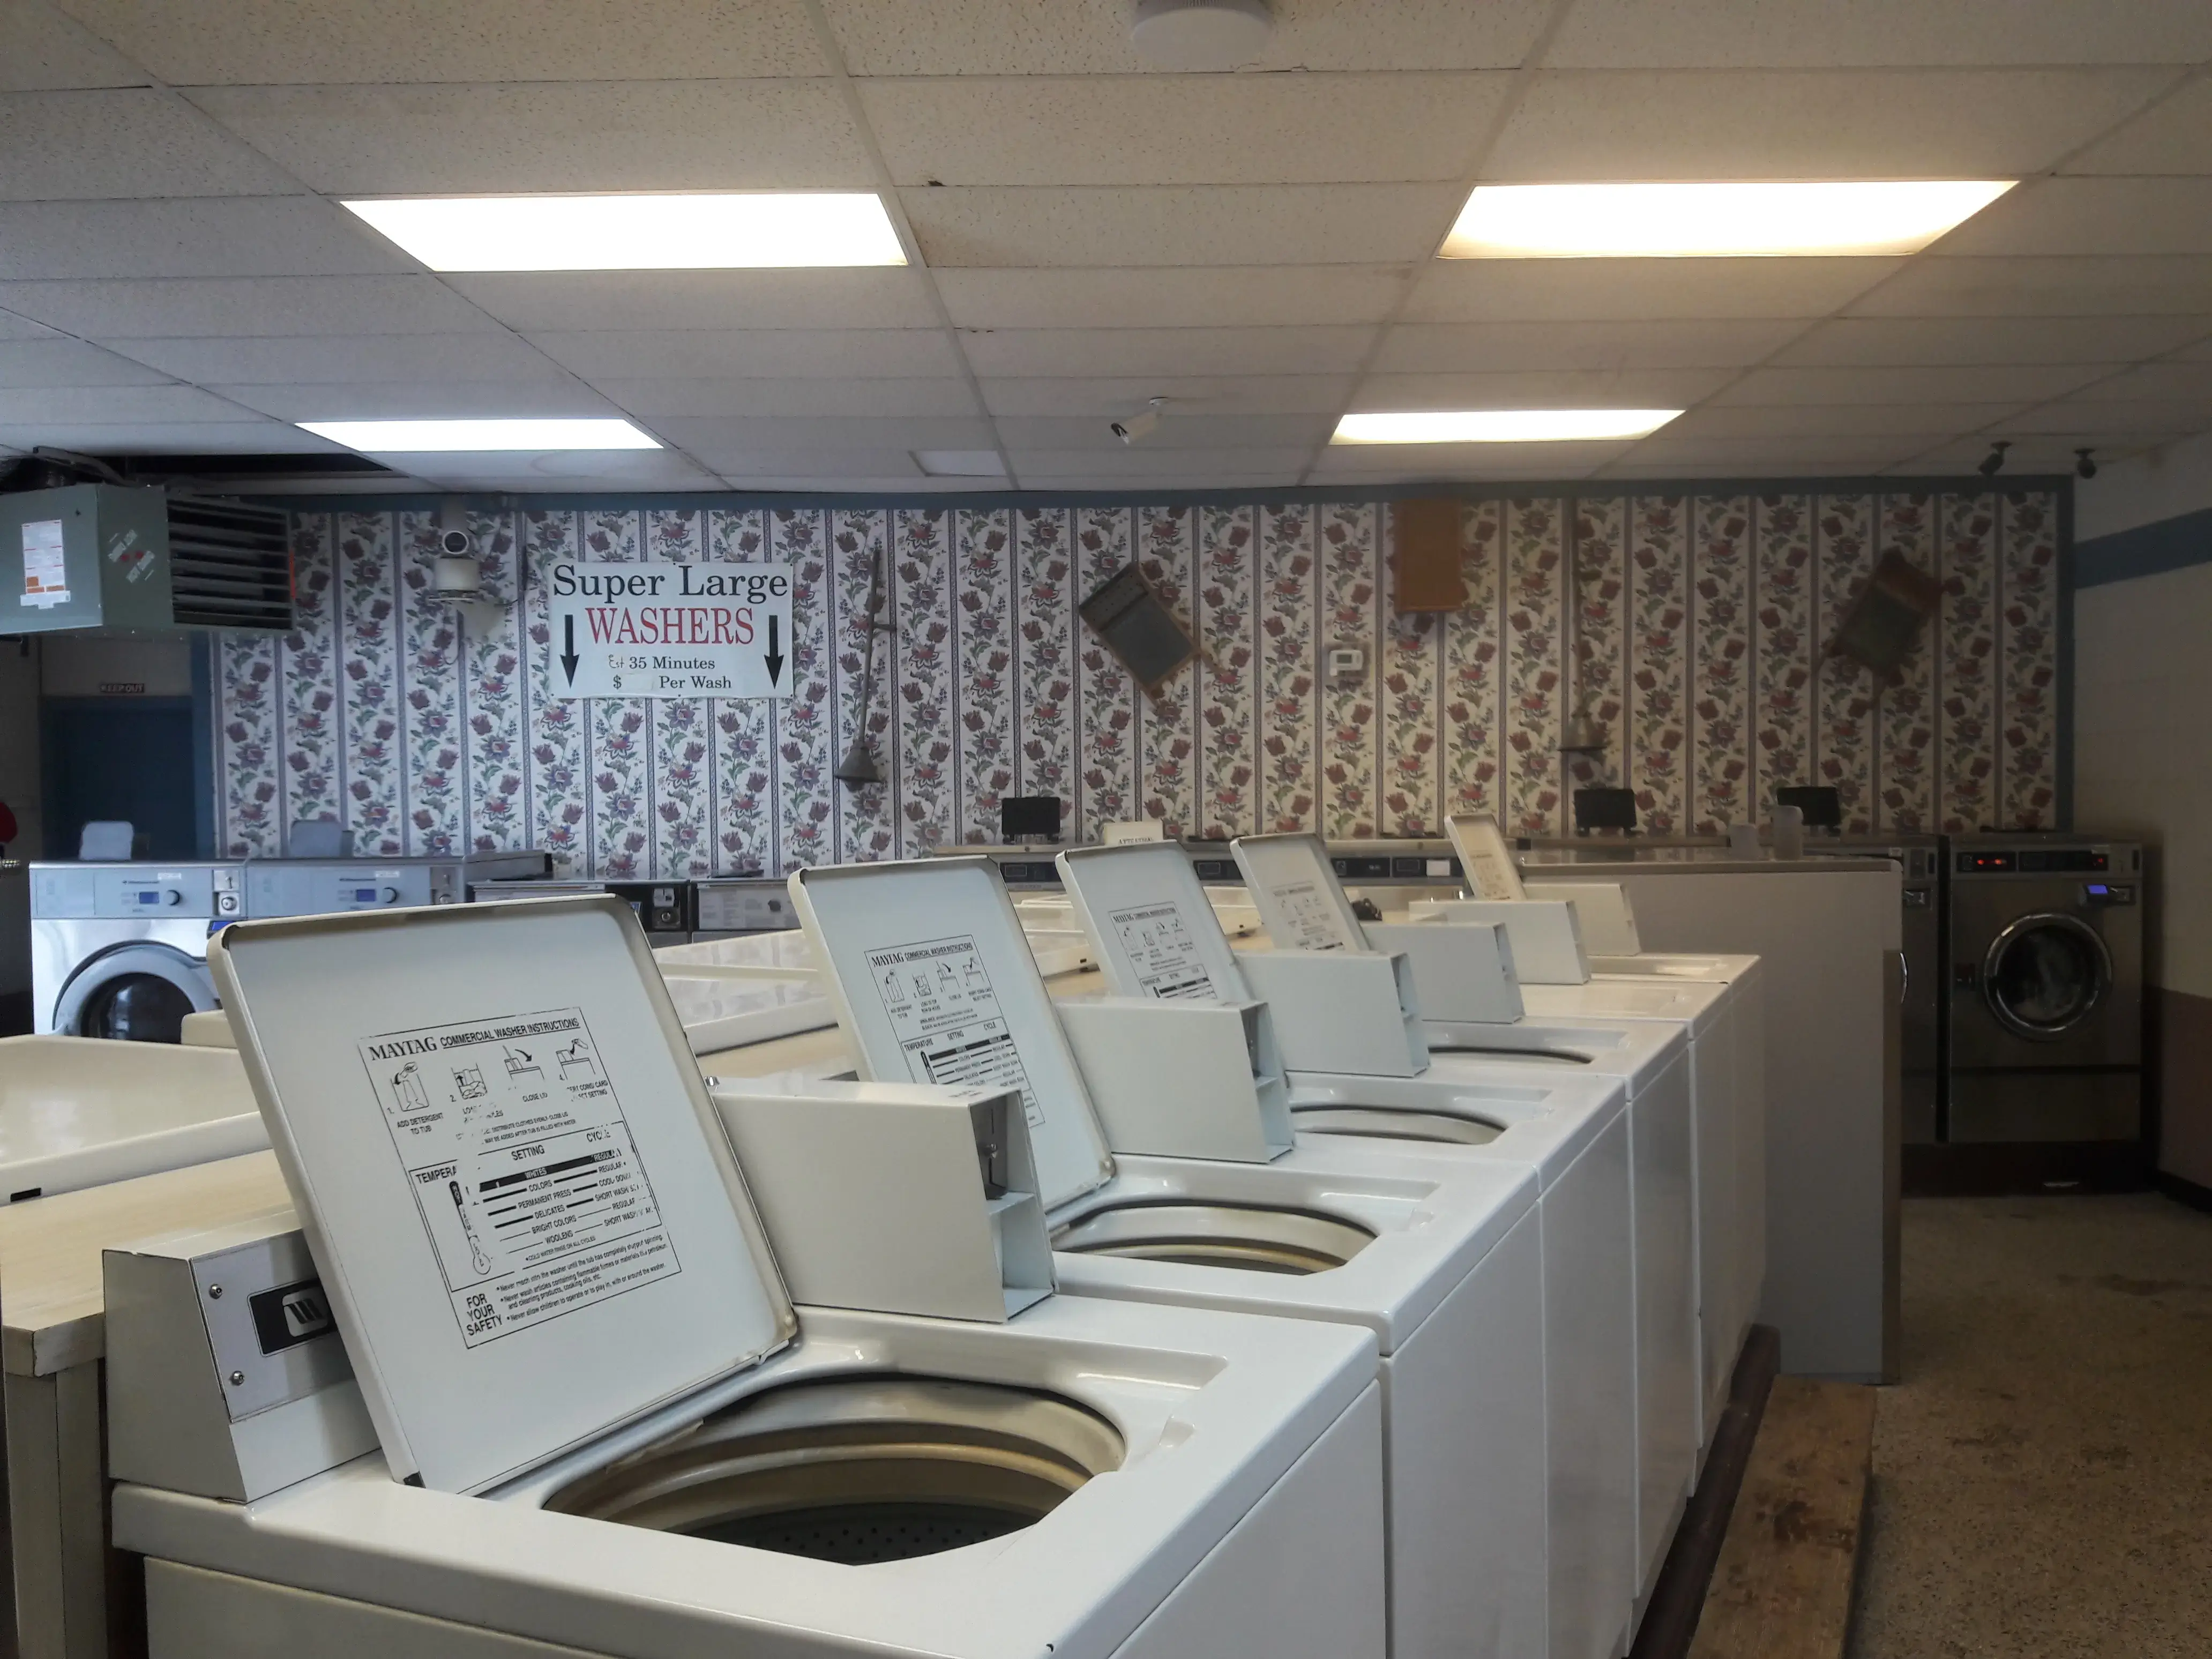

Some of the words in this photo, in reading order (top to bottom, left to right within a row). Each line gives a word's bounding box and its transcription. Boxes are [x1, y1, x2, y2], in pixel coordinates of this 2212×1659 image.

[554, 564, 665, 603] Super
[679, 565, 788, 604] Large
[585, 607, 754, 644] WASHERS
[629, 656, 647, 669] 35
[653, 656, 715, 669] Minutes
[100, 684, 124, 692] KEEP
[125, 684, 144, 692] OUT
[613, 674, 622, 690] $
[659, 675, 686, 689] Per
[690, 675, 732, 689] Wash
[871, 952, 904, 968] MAYTAG
[905, 949, 931, 960] COMMERCIAL
[368, 1037, 437, 1060] MAYTAG
[440, 1030, 495, 1047] COMMERCIAL
[494, 1025, 527, 1038] WASHER
[527, 1018, 579, 1033] INSTRUCTIONS
[904, 1038, 933, 1052] TEMPERATURE
[947, 1029, 964, 1041] SETTING
[984, 1021, 996, 1030] CYCLE
[522, 1093, 540, 1102] CLOSE
[588, 1088, 608, 1098] SETTING
[397, 1119, 410, 1128] ADD
[409, 1112, 443, 1125] DETERGENT
[511, 1145, 545, 1161] SETTING
[524, 1167, 548, 1179] WHITES
[518, 1194, 552, 1209] PERMANENT
[553, 1189, 571, 1199] PRESS
[599, 1178, 615, 1186] COOL
[529, 1179, 552, 1192] COLORS
[534, 1205, 565, 1219] DELICATES
[595, 1191, 613, 1201] SHORT
[613, 1186, 629, 1196] WASH
[532, 1222, 552, 1234] BRIGHT
[554, 1215, 577, 1227] COLORS
[545, 1230, 573, 1244] WOOLENS
[604, 1215, 621, 1227] SHORT
[500, 1283, 515, 1291] Never
[550, 1266, 566, 1275] washer
[567, 1261, 578, 1270] until
[603, 1246, 626, 1258] completely
[504, 1293, 519, 1302] Never
[519, 1289, 533, 1297] wash
[534, 1283, 551, 1292] articles
[552, 1274, 577, 1287] containing
[577, 1266, 600, 1277] flammable
[600, 1261, 614, 1270] fumes
[620, 1253, 639, 1263] materials
[466, 1293, 487, 1309] FOR
[508, 1301, 518, 1310] and
[519, 1295, 540, 1306] cleaning
[564, 1280, 582, 1290] cooking
[510, 1312, 525, 1321] Never
[526, 1307, 539, 1316] allow
[540, 1300, 560, 1312] children
[566, 1291, 584, 1302] operate
[595, 1284, 605, 1292] play
[627, 1269, 642, 1280] around
[467, 1304, 495, 1321] YOUR
[467, 1314, 502, 1336] SAFETY
